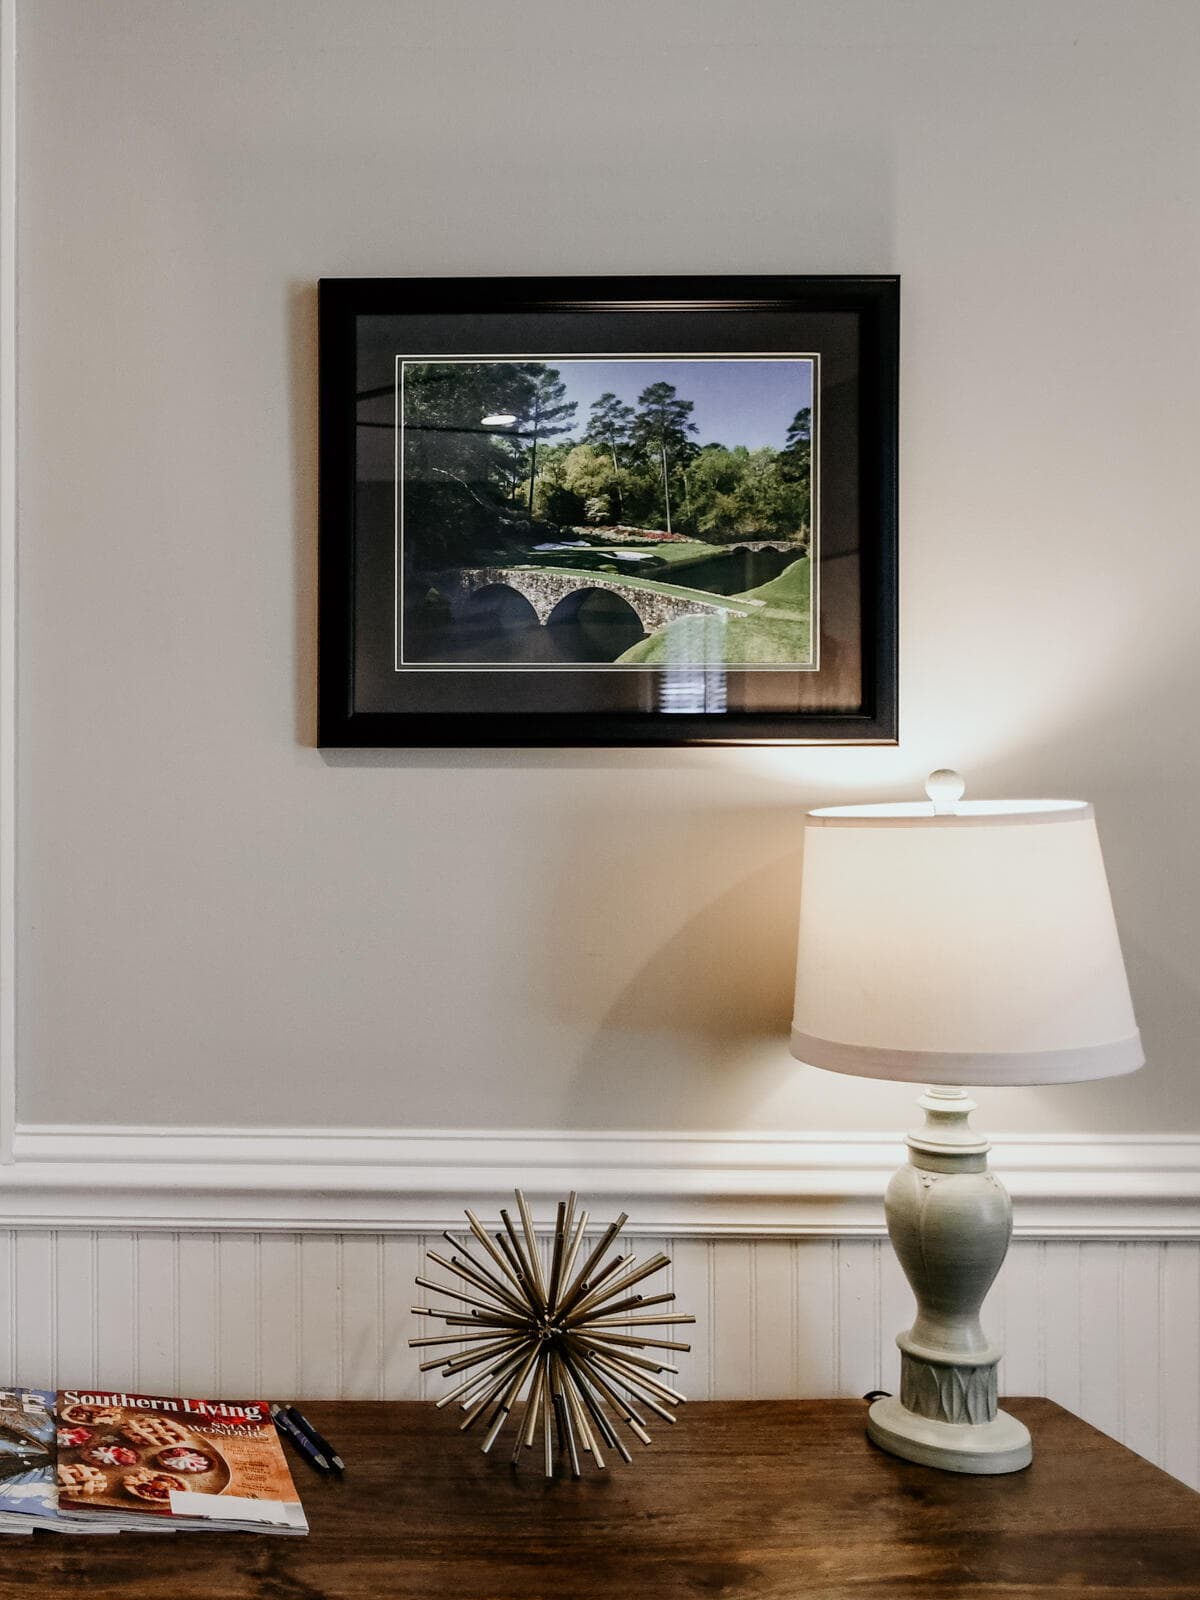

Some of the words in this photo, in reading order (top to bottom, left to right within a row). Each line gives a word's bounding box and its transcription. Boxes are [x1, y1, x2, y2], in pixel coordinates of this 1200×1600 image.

[63, 1391, 179, 1413] Southern
[183, 1399, 263, 1421] Living
[187, 1425, 269, 1438] WONDERS
